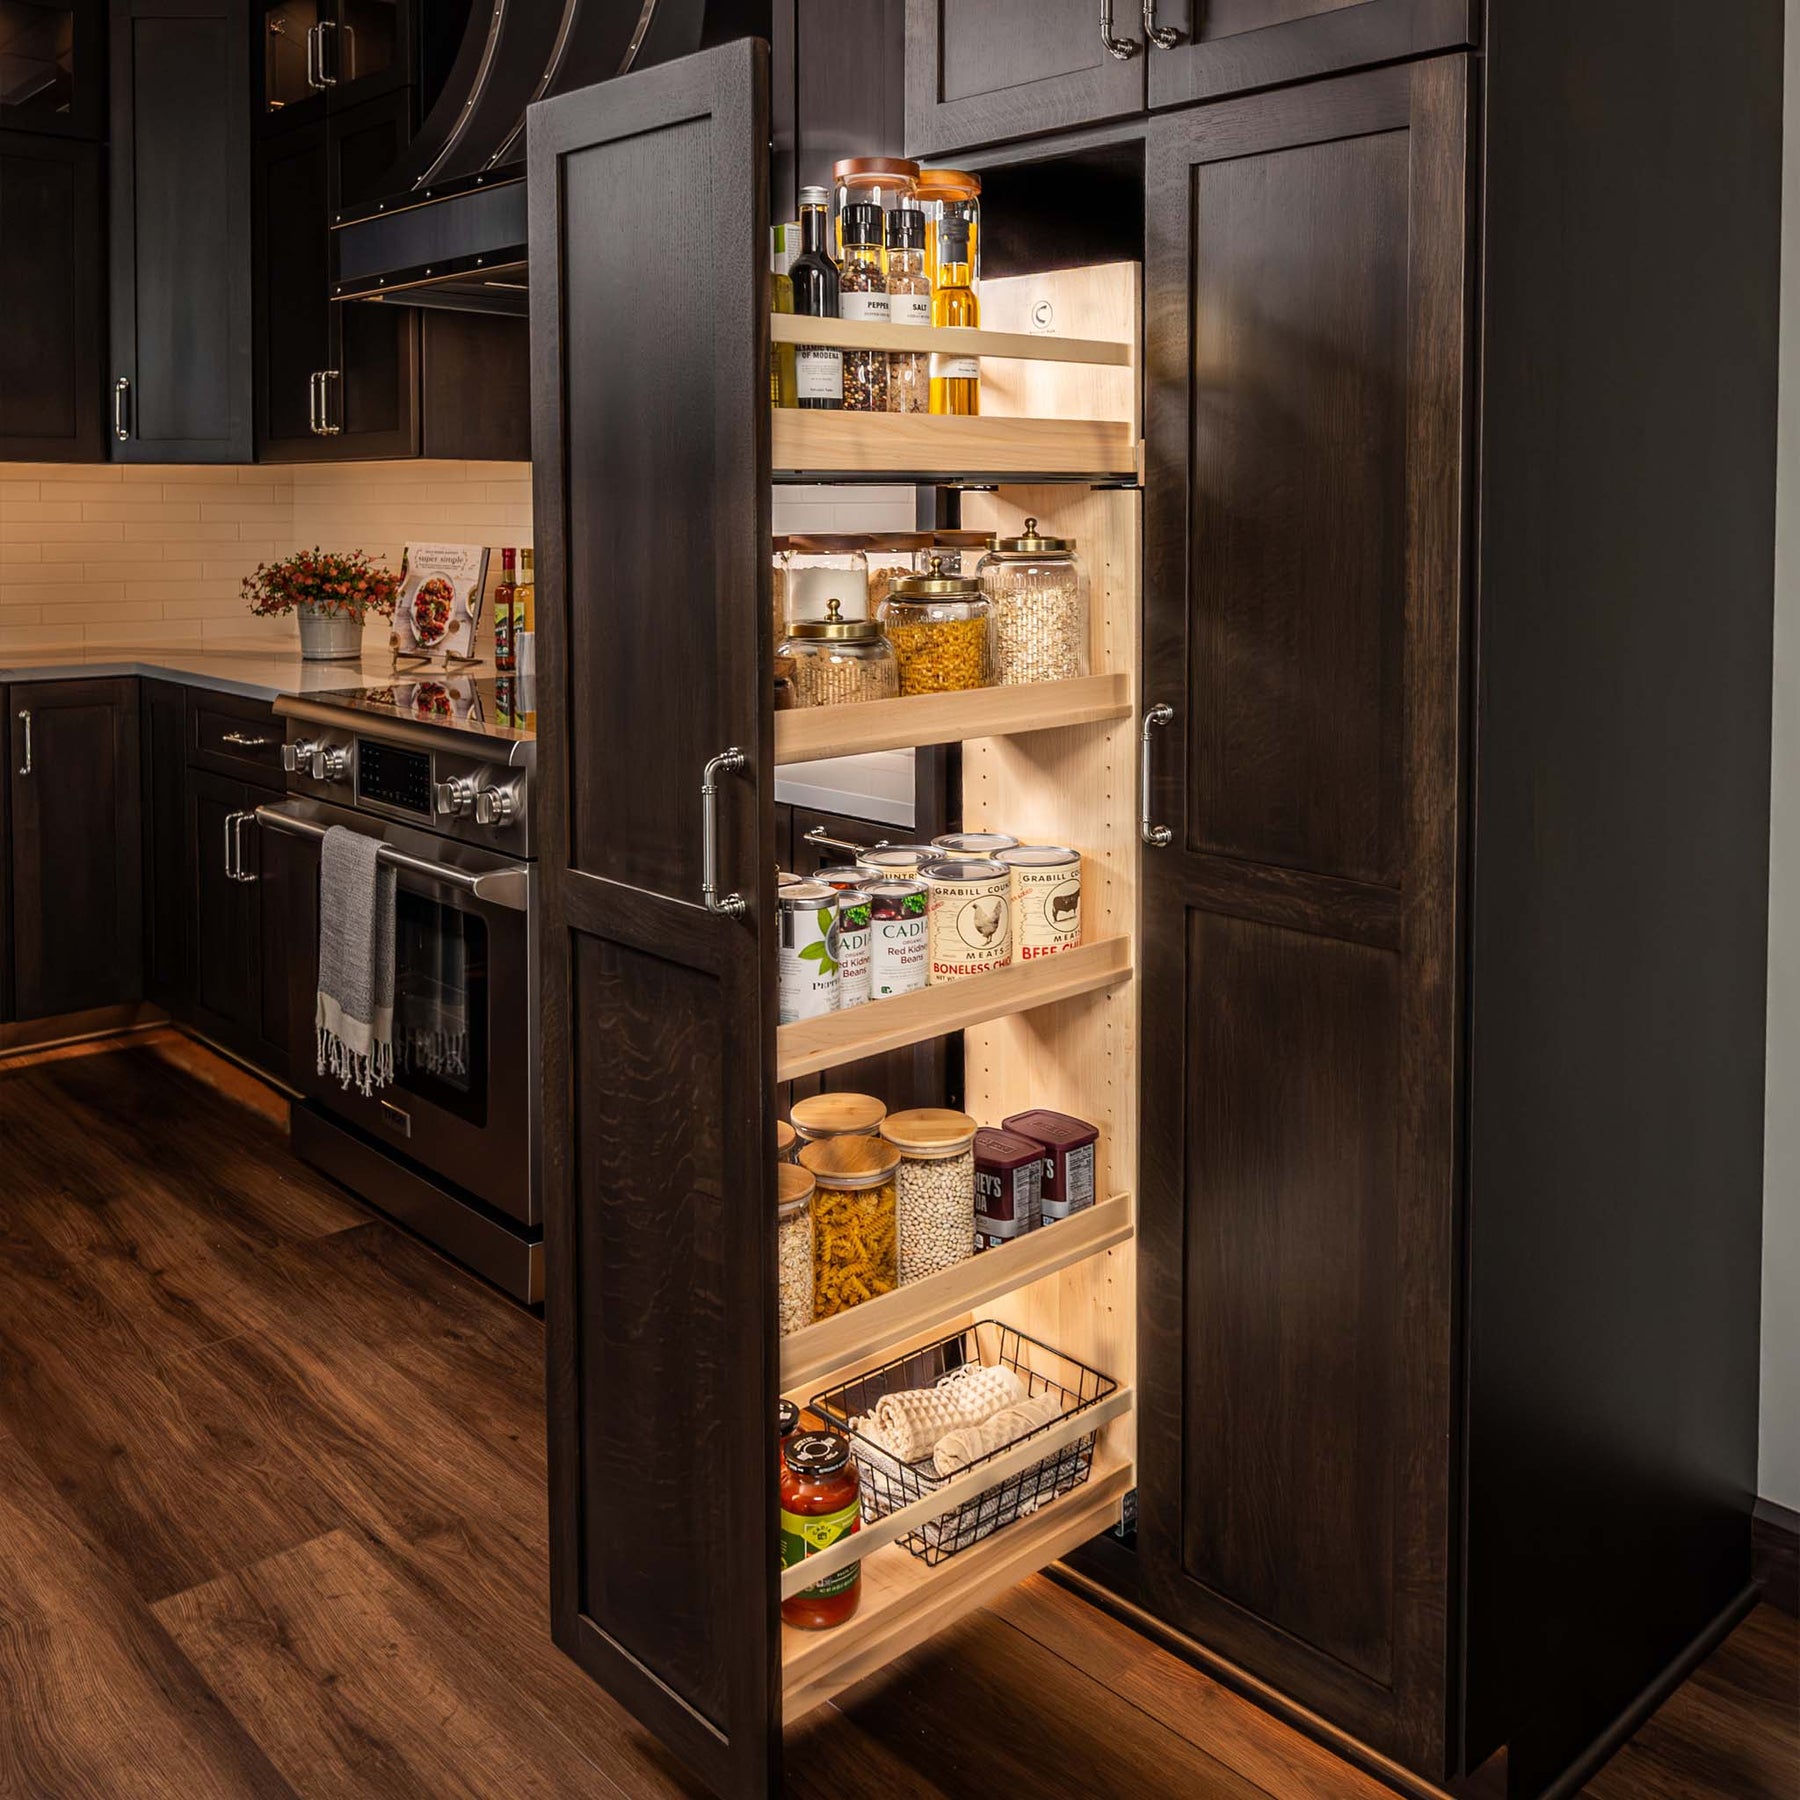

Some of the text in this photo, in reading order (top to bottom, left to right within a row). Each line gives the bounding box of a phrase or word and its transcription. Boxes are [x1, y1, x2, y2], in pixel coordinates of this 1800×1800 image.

[912, 303, 927, 311] SALT
[440, 556, 464, 565] simple
[1022, 874, 1066, 882] GRABILL
[935, 887, 980, 896] GRABILL
[840, 932, 872, 950] ADI
[887, 947, 906, 956] Red
[965, 947, 1005, 960] MEATS
[900, 954, 924, 964] Beans
[843, 968, 867, 978] Beans
[933, 962, 991, 975] BONELESS
